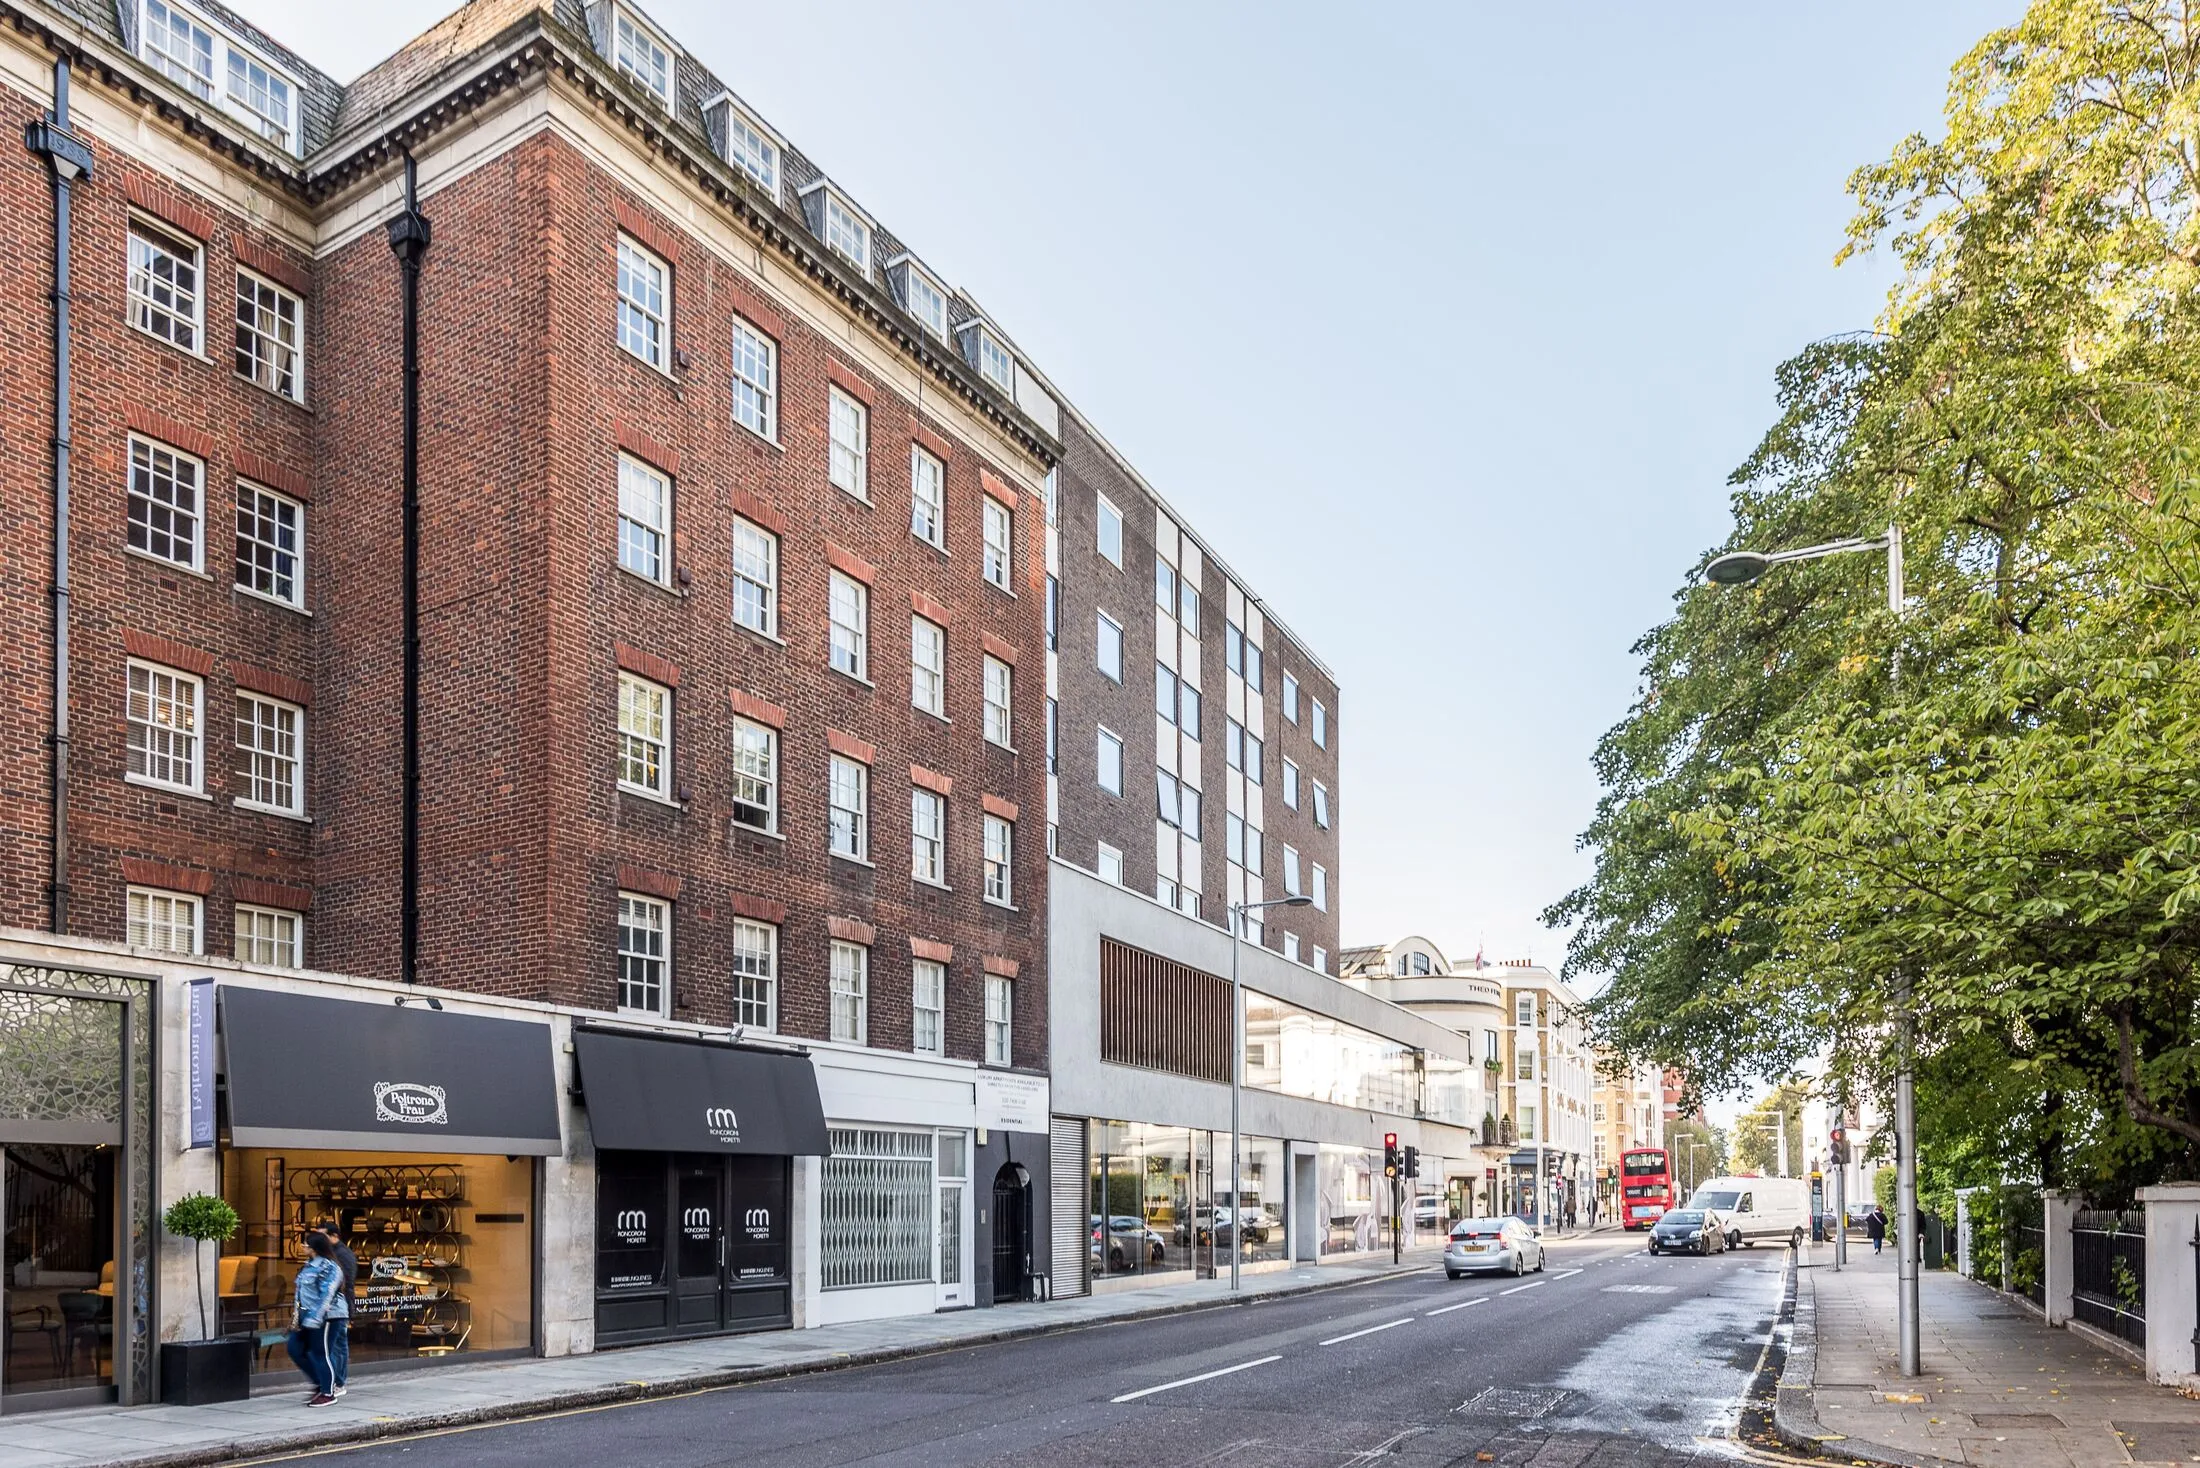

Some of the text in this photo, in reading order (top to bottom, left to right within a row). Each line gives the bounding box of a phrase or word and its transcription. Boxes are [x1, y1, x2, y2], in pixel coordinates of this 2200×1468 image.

[391, 1092, 435, 1106] Poltrona
[400, 1103, 425, 1115] Frau
[706, 1107, 738, 1129] rm
[617, 1210, 646, 1230] rm
[684, 1207, 710, 1226] rm
[746, 1208, 769, 1226] rm
[354, 1293, 436, 1305] nnecting Experiences
[356, 1305, 368, 1313] New
